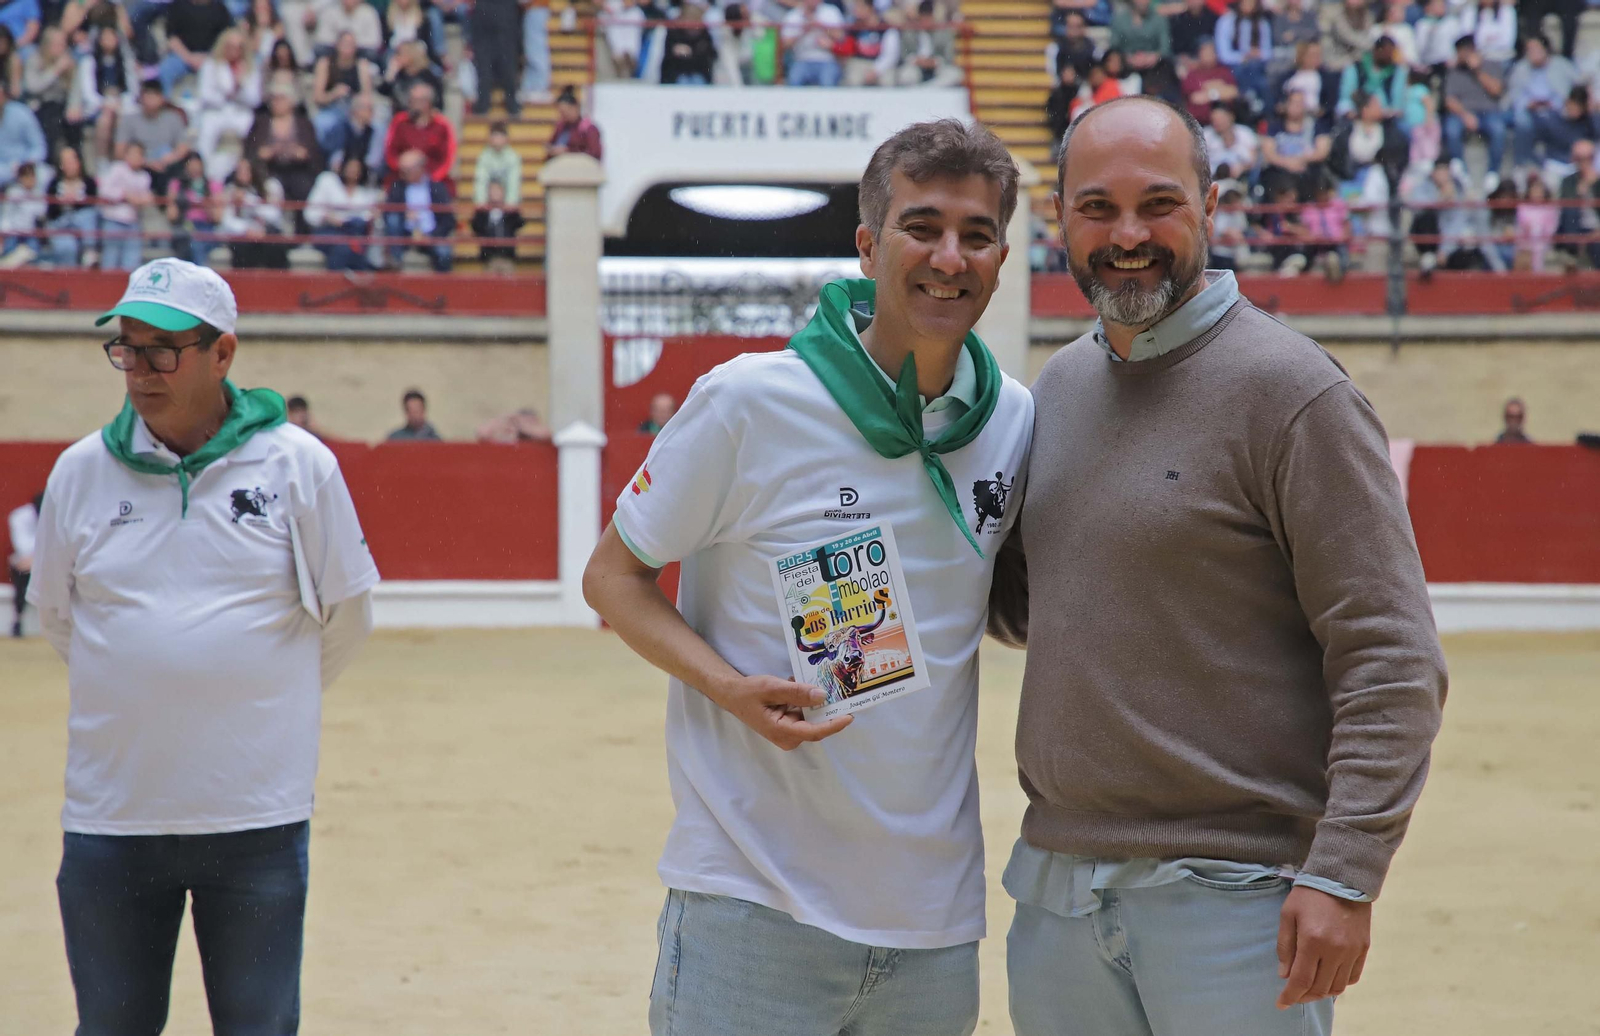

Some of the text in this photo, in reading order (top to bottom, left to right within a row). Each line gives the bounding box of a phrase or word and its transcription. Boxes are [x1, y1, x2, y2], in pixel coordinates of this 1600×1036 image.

[673, 111, 872, 140] PUERTA GRANDE
[844, 537, 853, 545] 20
[853, 534, 862, 542] de
[862, 529, 877, 539] Abril
[779, 551, 813, 569] 2025
[815, 540, 886, 582] toro
[783, 564, 820, 582] Fiesta
[796, 574, 816, 589] del
[803, 606, 831, 619] Villa de
[824, 708, 839, 717] 2007
[871, 692, 881, 702] Gil
[881, 686, 906, 698] Montero
